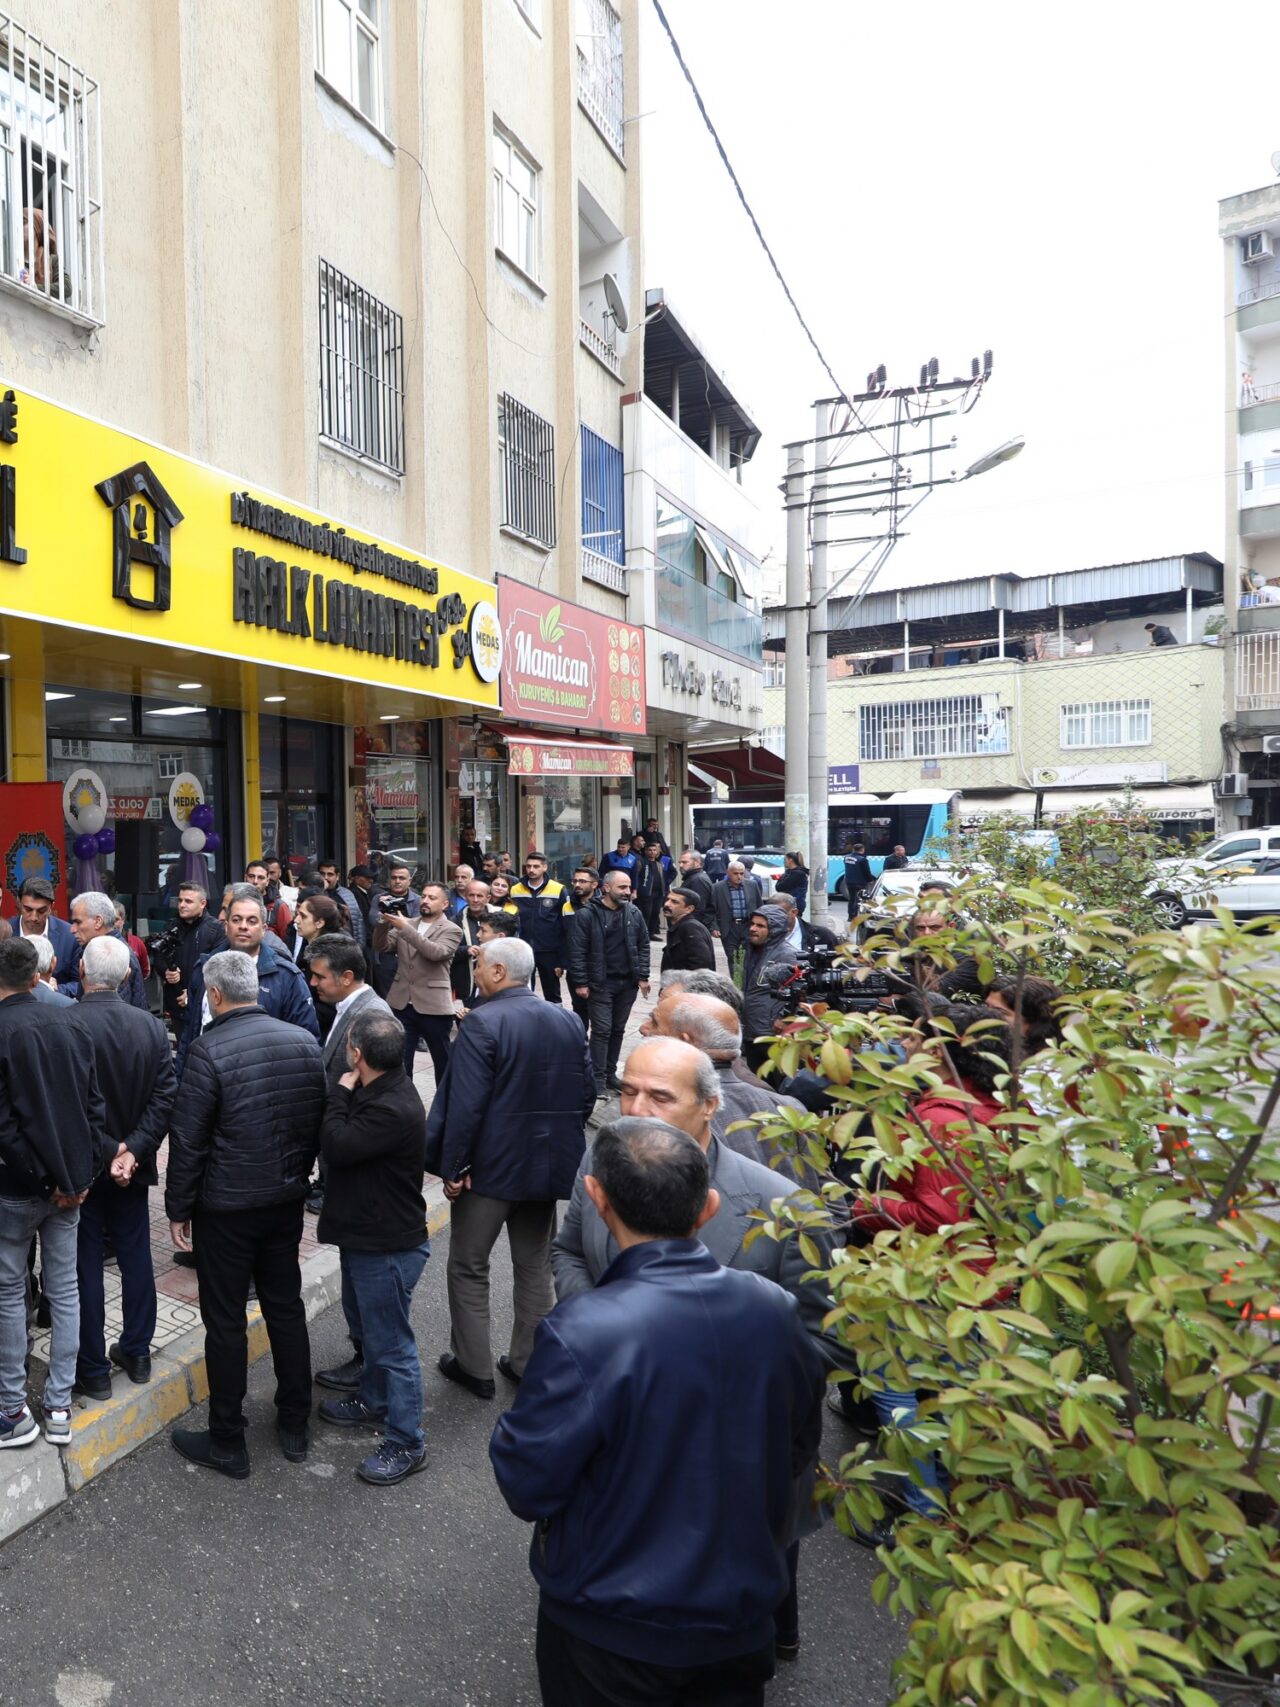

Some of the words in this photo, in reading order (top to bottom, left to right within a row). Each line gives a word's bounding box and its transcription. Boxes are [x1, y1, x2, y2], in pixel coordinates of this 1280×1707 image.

[230, 491, 313, 551] DİYARBAKIR
[313, 522, 385, 574] BÜYÜKŞEHİR
[384, 553, 438, 595] BELEDİYESİ
[233, 546, 311, 638] HALK
[313, 573, 439, 668] LOKANTASI
[515, 631, 588, 688] Mamican
[519, 682, 554, 706] KURUYEMİŞ
[560, 691, 587, 709] BAHARAT
[542, 751, 572, 770] Mamican
